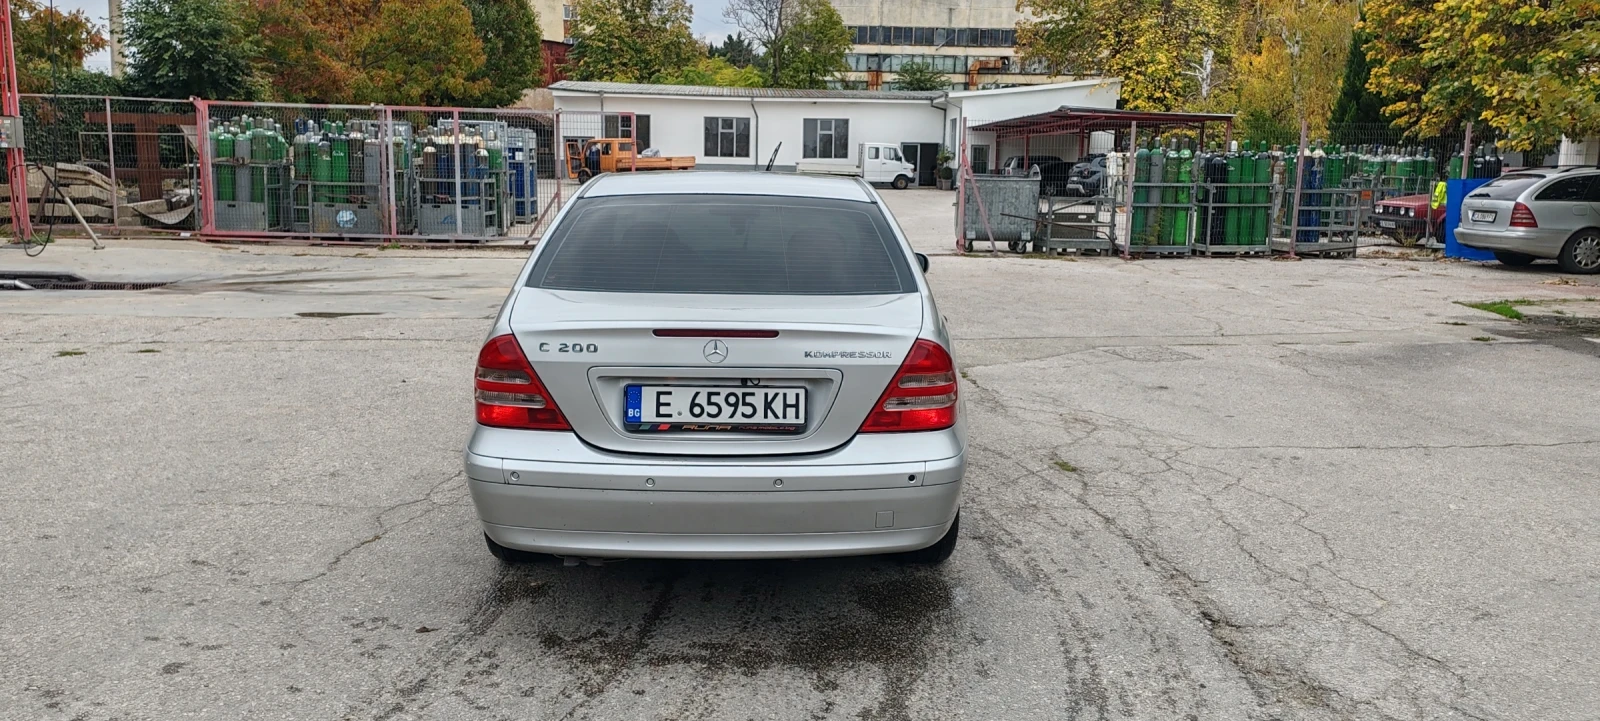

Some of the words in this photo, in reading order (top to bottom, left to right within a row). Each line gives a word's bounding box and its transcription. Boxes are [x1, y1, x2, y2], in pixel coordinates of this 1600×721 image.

[539, 342, 550, 352] C
[558, 343, 599, 353] 200
[804, 351, 892, 359] KOMPRESSOR
[689, 391, 758, 419] 6595
[628, 409, 640, 417] BG
